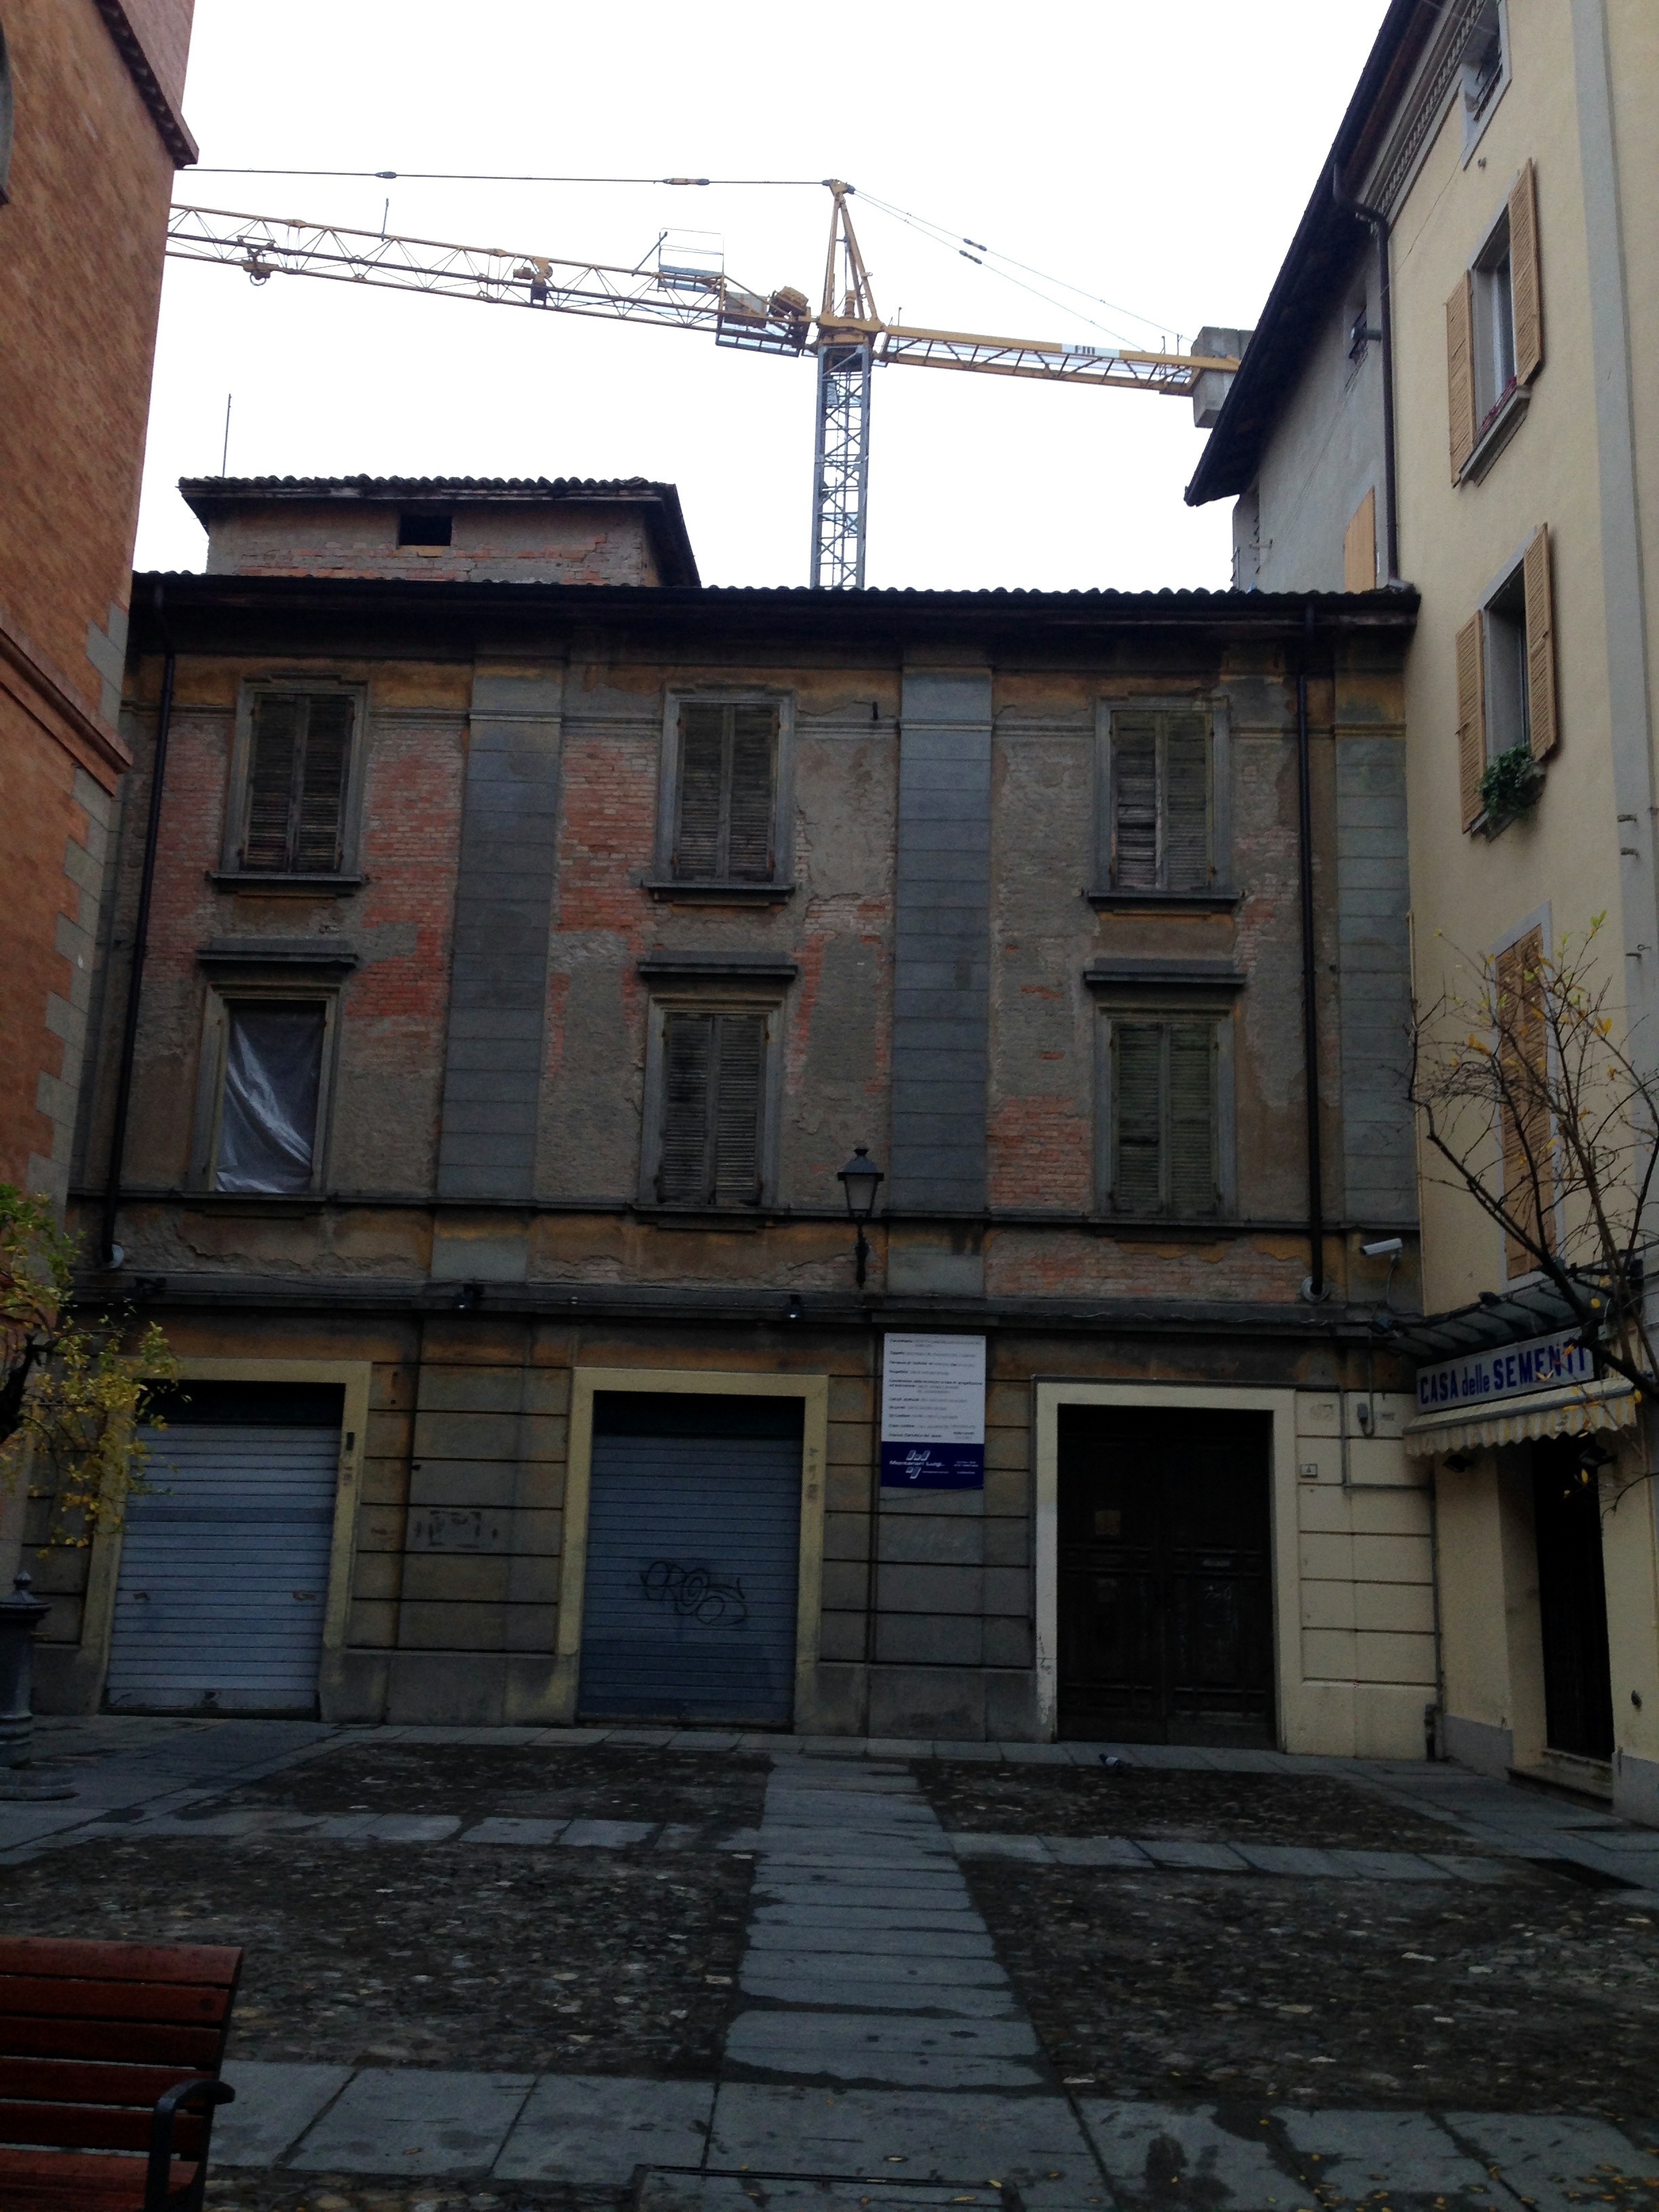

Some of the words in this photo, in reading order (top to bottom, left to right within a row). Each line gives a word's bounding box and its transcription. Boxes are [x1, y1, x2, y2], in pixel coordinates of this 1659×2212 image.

[1420, 1369, 1458, 1405] CASA
[1462, 1364, 1490, 1397] delle
[1493, 1337, 1585, 1391] SEMENTI
